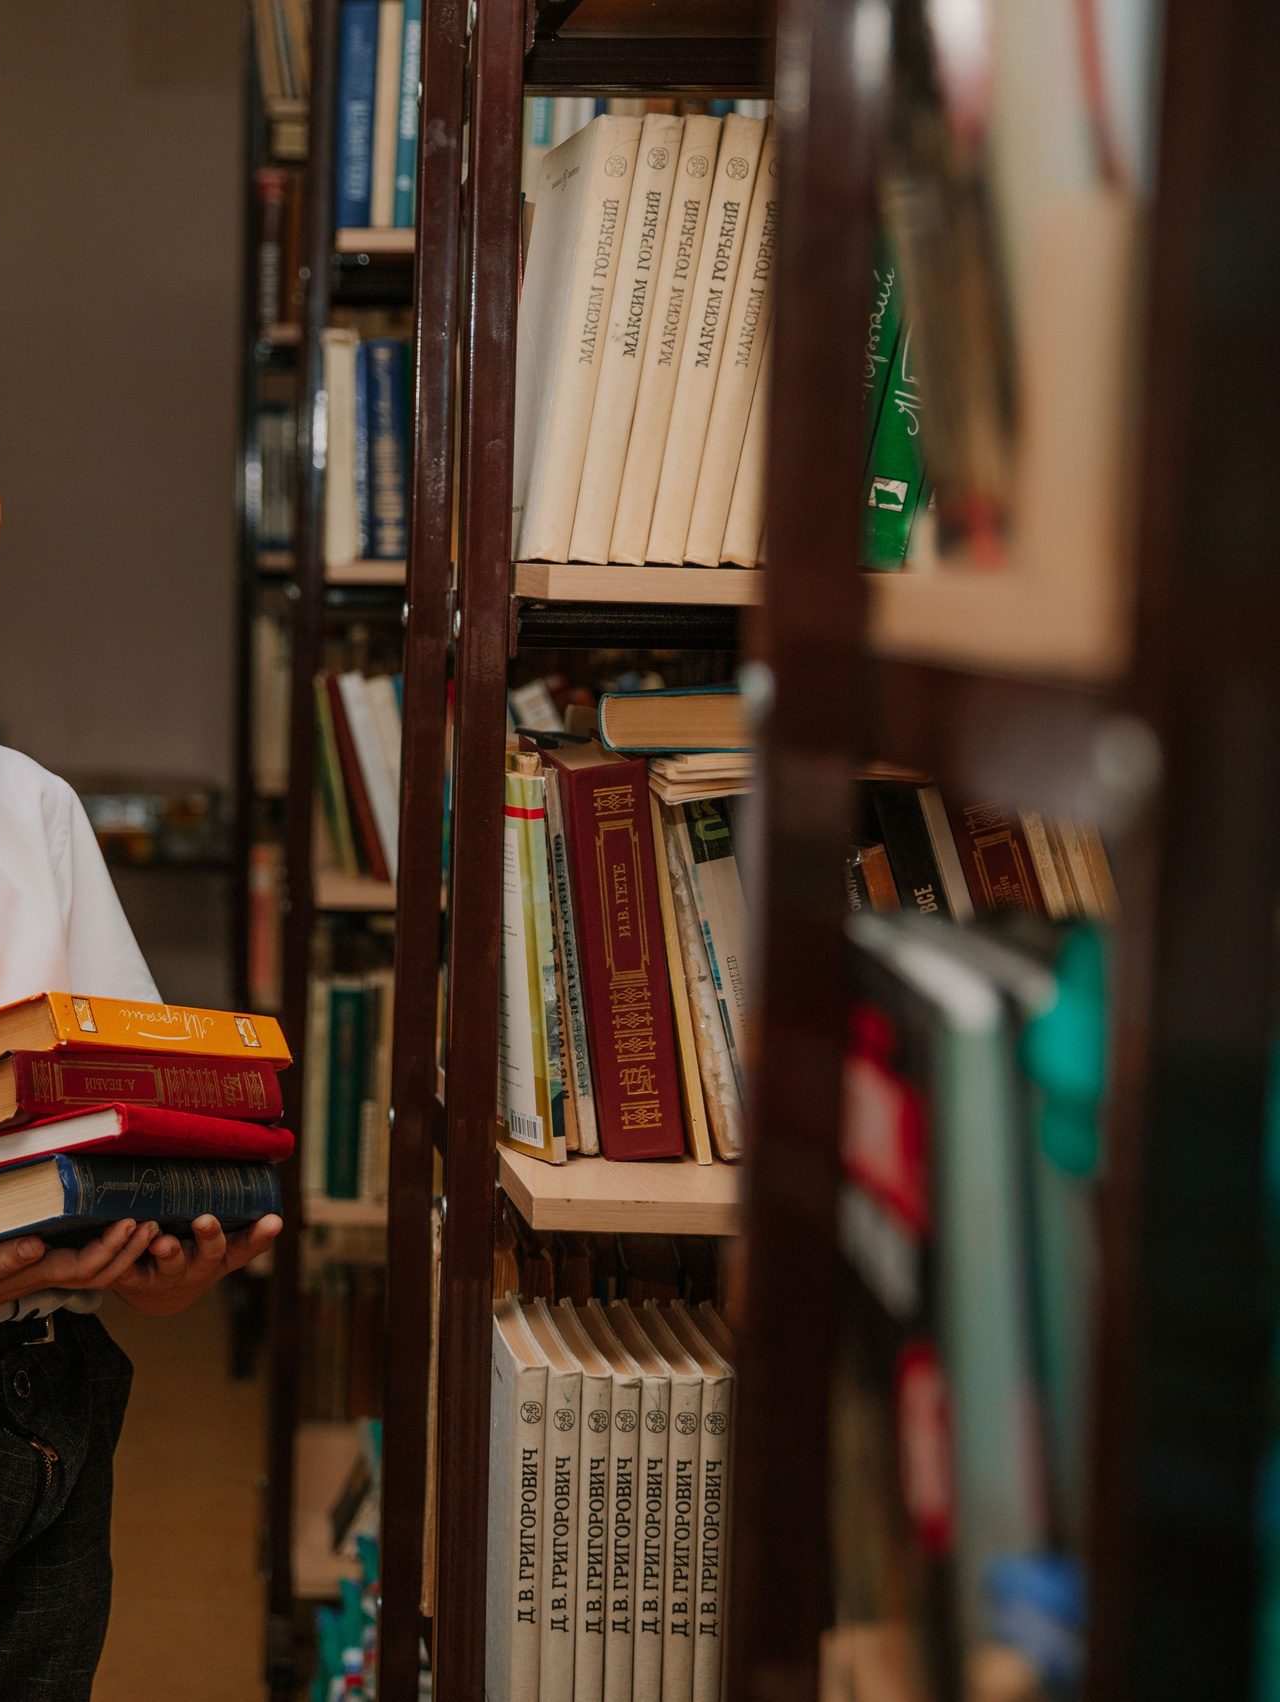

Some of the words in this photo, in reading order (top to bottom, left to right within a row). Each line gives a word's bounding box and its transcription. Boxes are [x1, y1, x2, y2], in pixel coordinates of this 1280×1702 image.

[579, 286, 604, 365] МАКСИМ
[593, 198, 620, 279] ГОРЬКИЙ
[623, 279, 648, 358] МАКСИМ
[637, 190, 661, 271] ГОРЬКИЙ
[658, 286, 684, 366] МАКСИМ
[674, 199, 700, 280] ГОРЬКИЙ
[695, 287, 723, 368] МАКСИМ
[712, 200, 740, 282] ГОРЬКИЙ
[735, 288, 764, 368] МАКСИМ
[613, 863, 628, 904] ГЕТЕ
[914, 883, 939, 915] ВСЕ
[726, 955, 746, 1009] ГОРДЕЕВ
[84, 1077, 122, 1093] БЕЛЫЙ
[123, 1078, 135, 1090] А.
[519, 1448, 538, 1580] ГРИГОРОВИЧ
[552, 1456, 571, 1589] ГРИГОРОВИЧ
[587, 1457, 605, 1591] ГРИГОРОВИЧ
[613, 1457, 632, 1591] ГРИГОРОВИЧ
[643, 1457, 663, 1591] ГРИГОРОВИЧ
[672, 1459, 692, 1593] ГРИГОРОВИЧ
[702, 1459, 722, 1593] ГРИГОРОВИЧ
